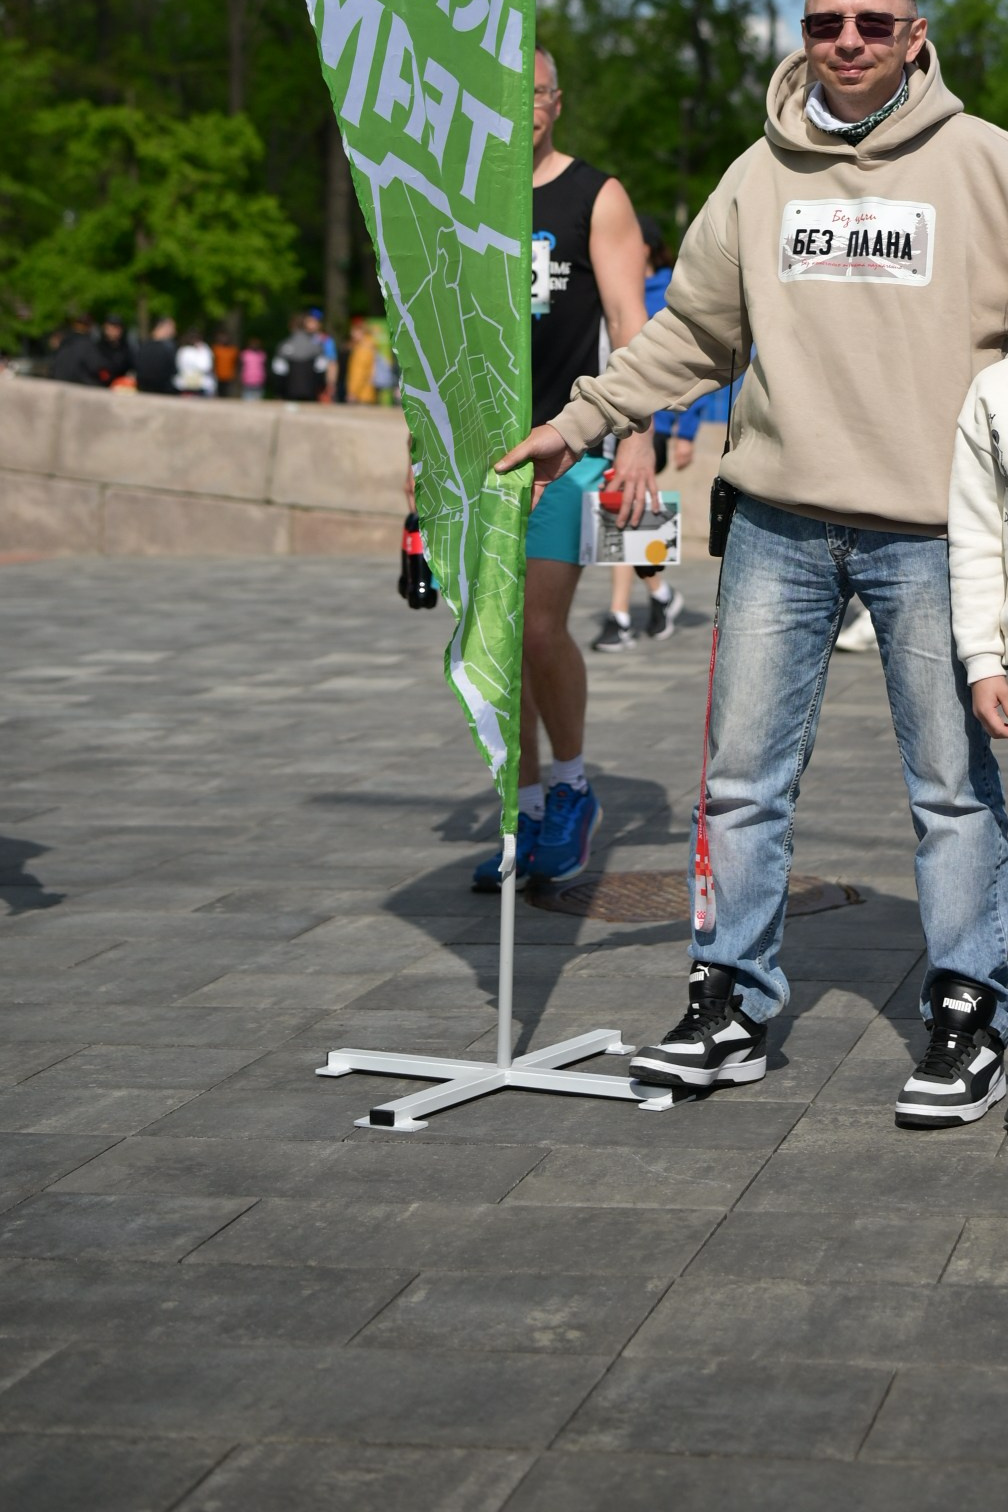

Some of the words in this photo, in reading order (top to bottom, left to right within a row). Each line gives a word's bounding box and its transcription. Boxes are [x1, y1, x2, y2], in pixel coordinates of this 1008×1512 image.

[792, 228, 834, 256] БЕЗ
[846, 229, 913, 261] ПЛАНА
[942, 997, 972, 1013] PUMA
